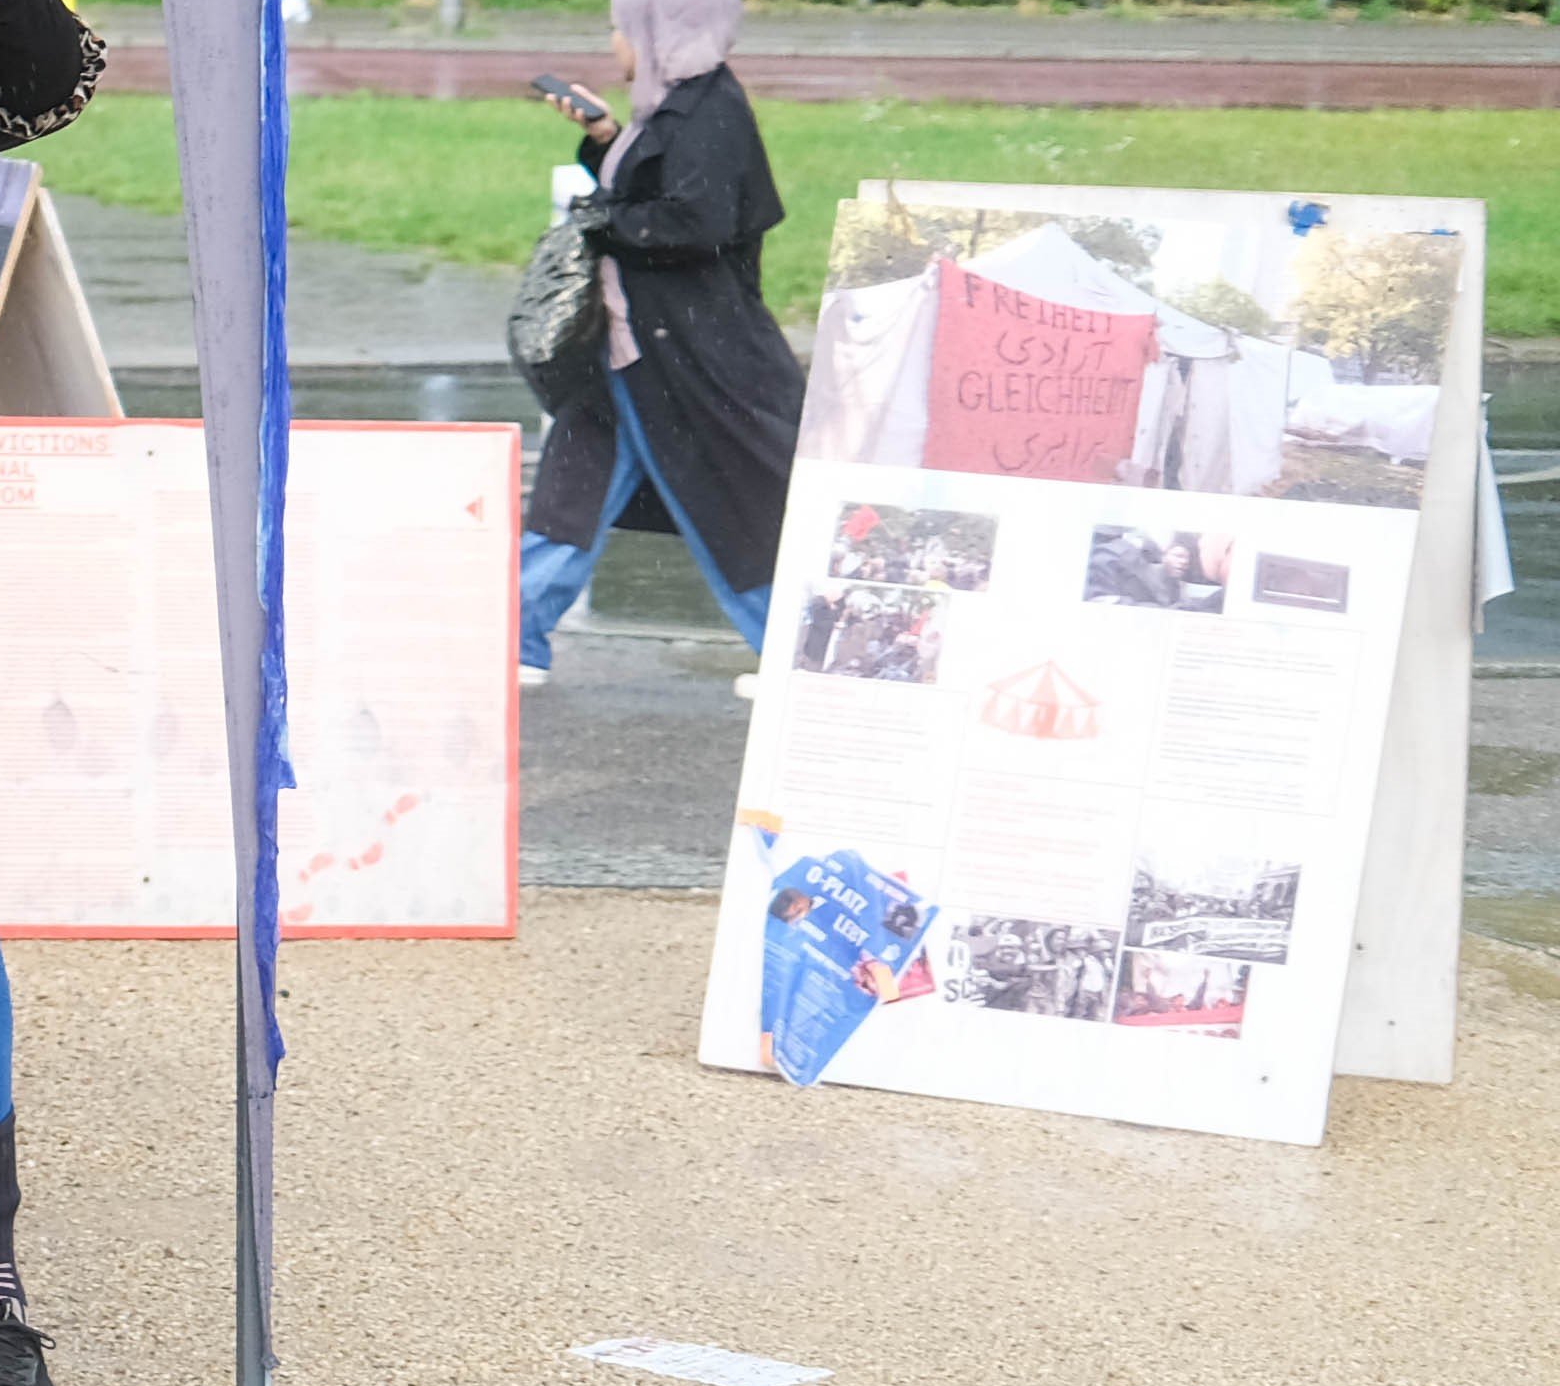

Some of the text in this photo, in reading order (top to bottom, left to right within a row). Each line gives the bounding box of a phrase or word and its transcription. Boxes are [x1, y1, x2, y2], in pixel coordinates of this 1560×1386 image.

[964, 272, 1113, 334] FREIHEIT
[958, 370, 1136, 415] GLEICHHEIT
[806, 865, 869, 916] O-PLATZ
